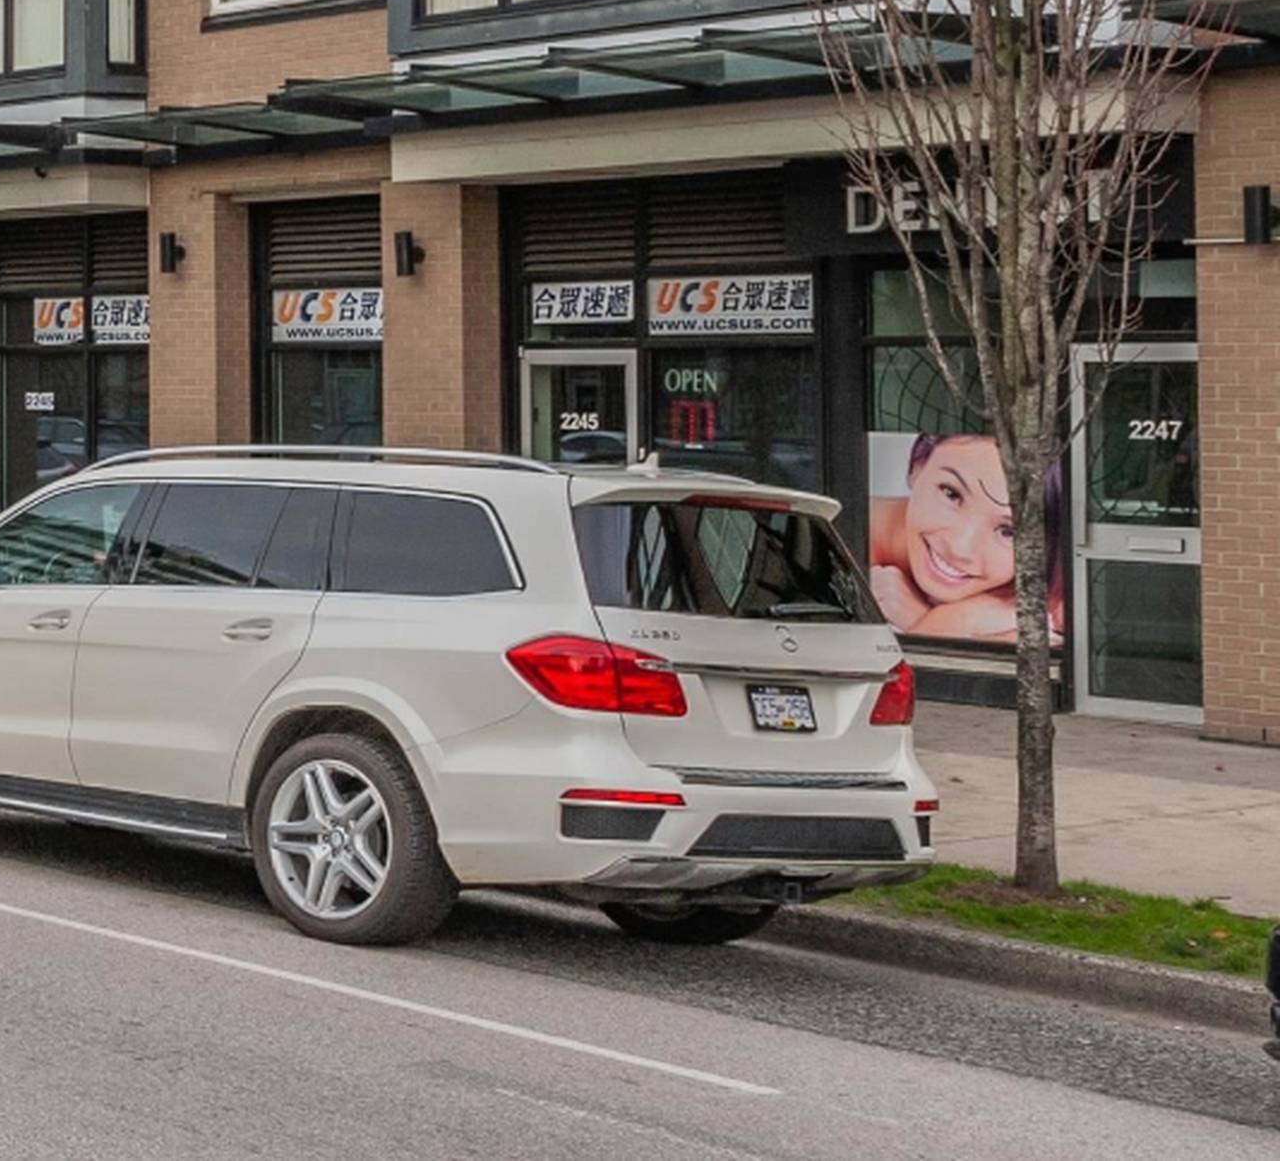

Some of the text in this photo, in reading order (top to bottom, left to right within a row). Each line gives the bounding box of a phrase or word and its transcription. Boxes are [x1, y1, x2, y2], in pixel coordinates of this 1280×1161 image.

[278, 291, 383, 324] UCS 合眾
[656, 280, 720, 314] UCS
[37, 301, 83, 329] UCS
[650, 316, 814, 332] www.ucsus.com
[664, 368, 719, 394] OPEN
[559, 412, 600, 431] 2245
[1128, 419, 1183, 440] 2247
